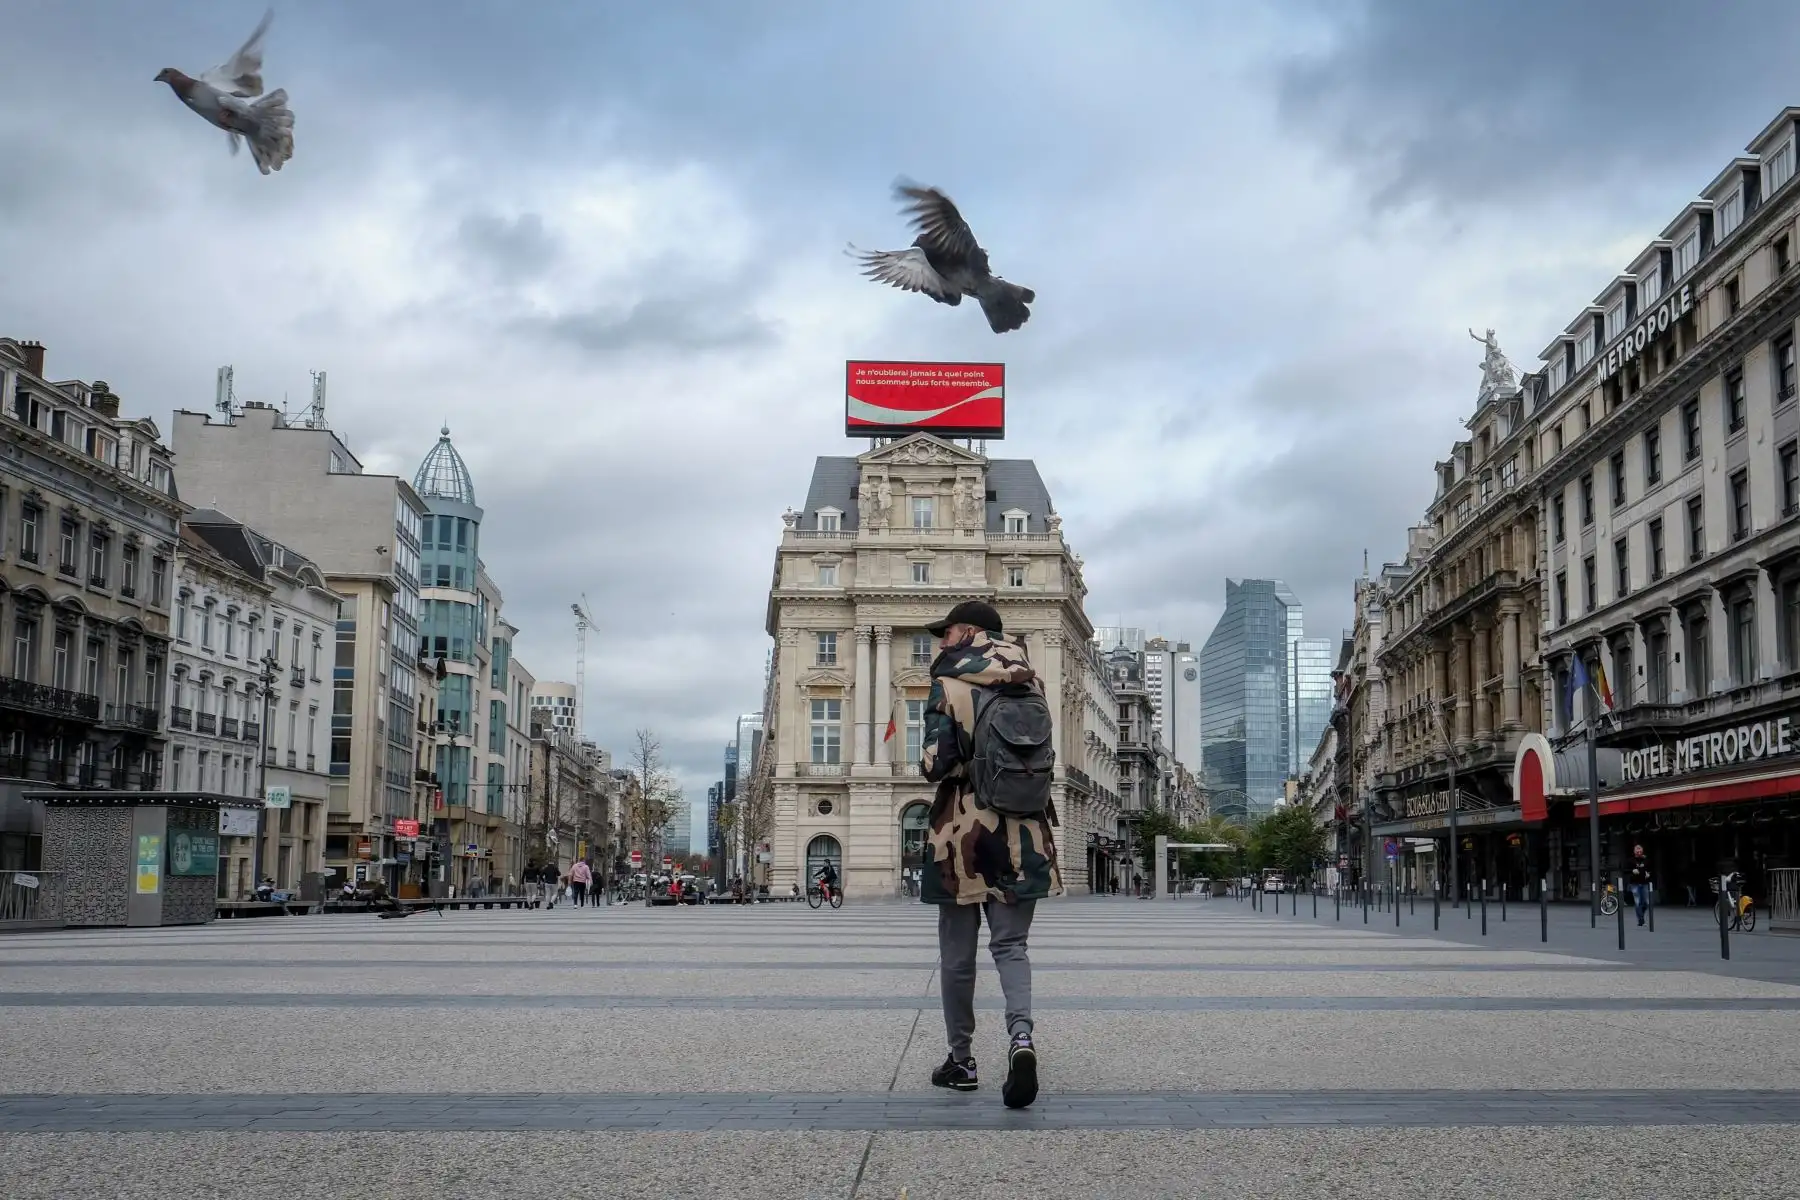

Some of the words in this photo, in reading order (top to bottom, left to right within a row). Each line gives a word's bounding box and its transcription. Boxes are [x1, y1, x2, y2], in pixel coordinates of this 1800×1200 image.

[1597, 284, 1692, 384] METROPOLE
[856, 368, 866, 376] Je
[910, 370, 937, 378] jamais
[944, 370, 962, 378] quel
[1621, 744, 1668, 781] HOTEL
[1676, 717, 1791, 770] METROPOLE
